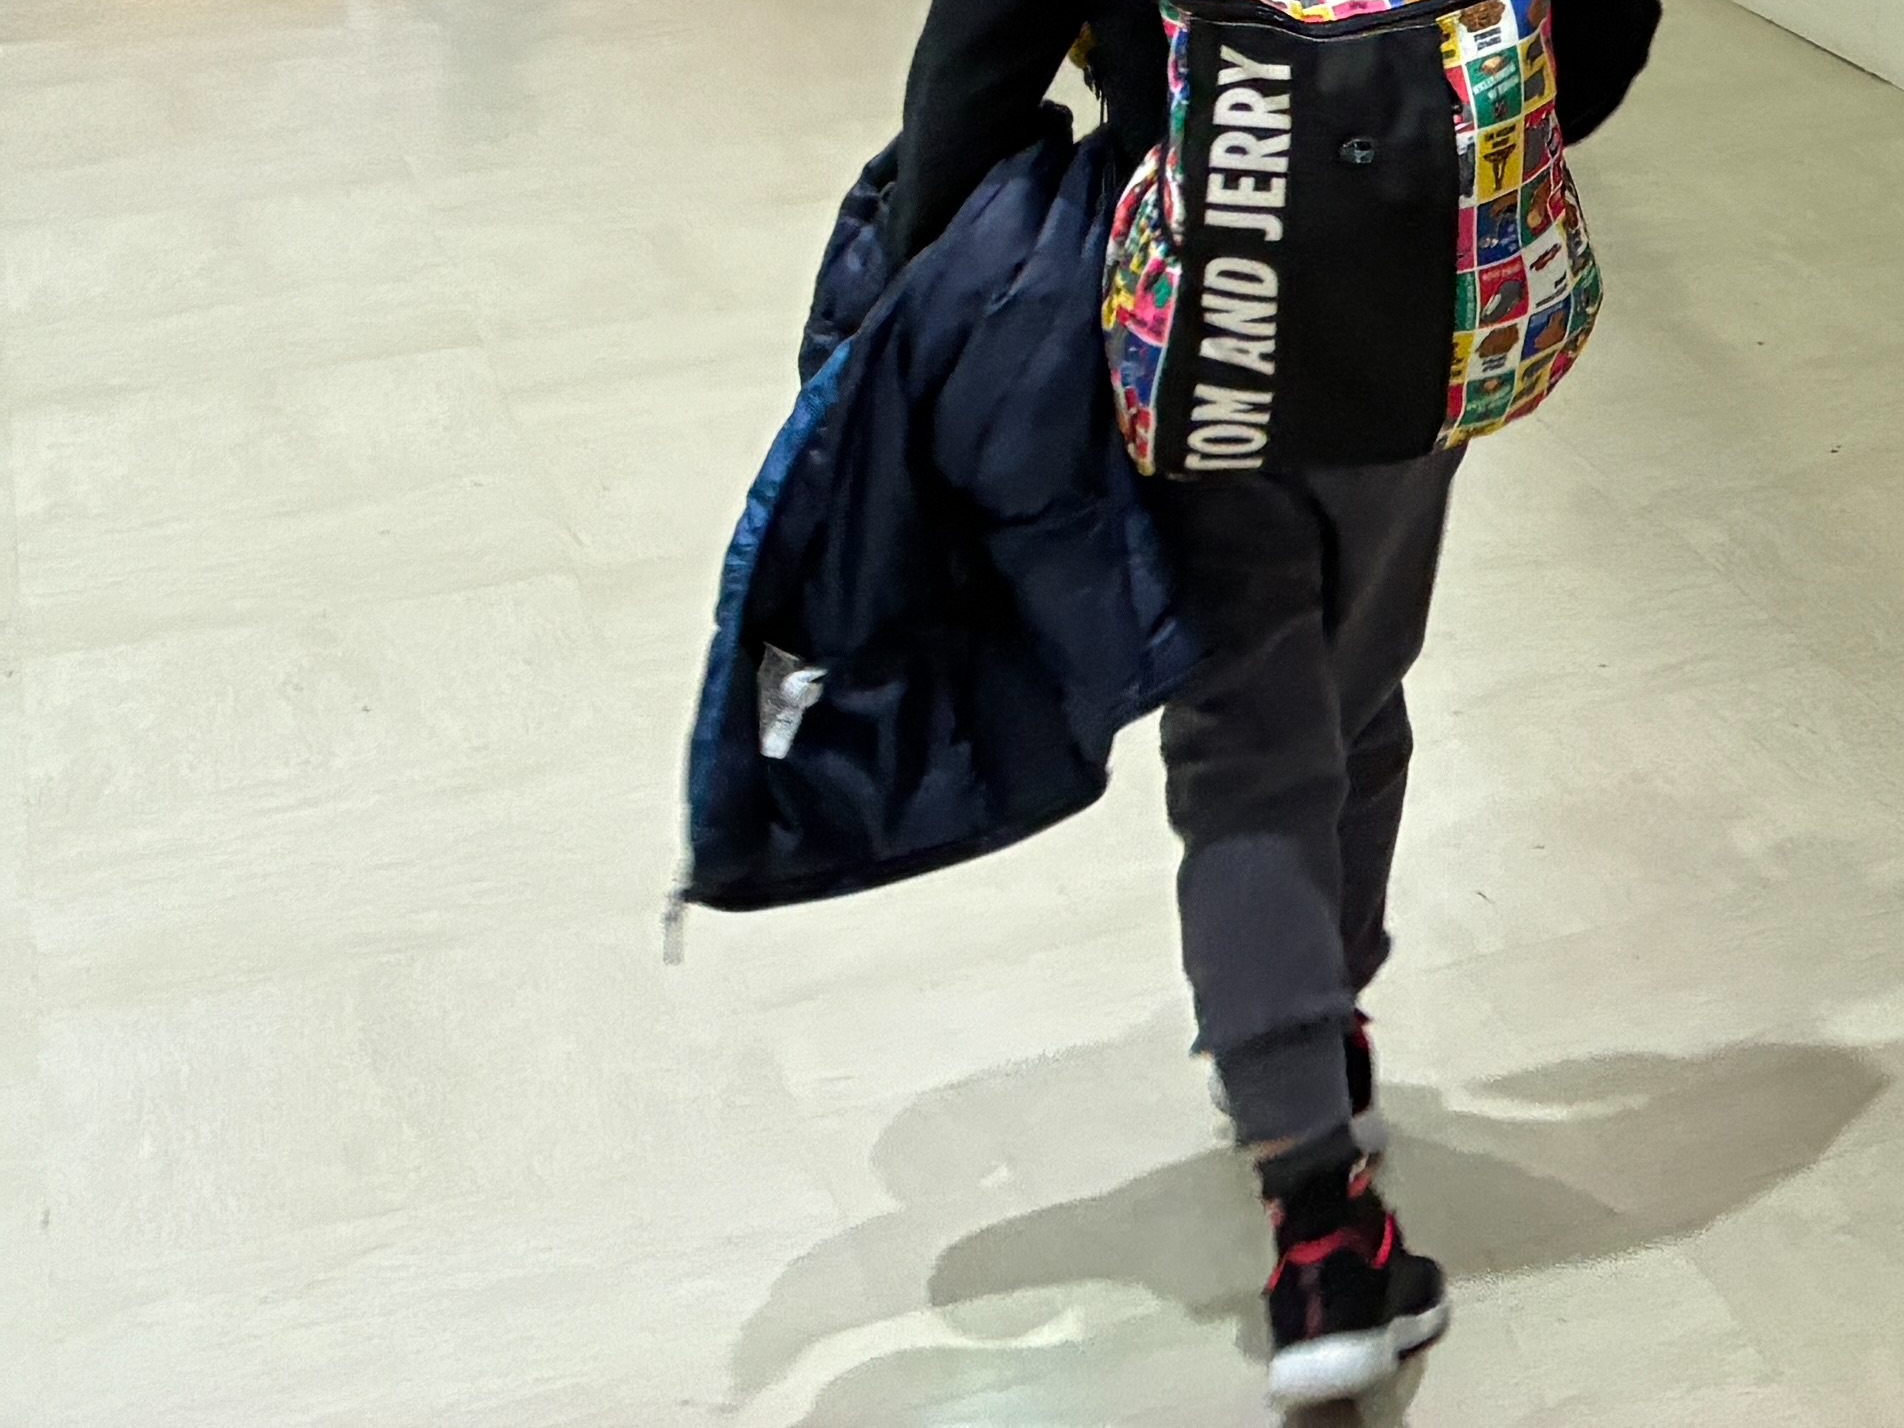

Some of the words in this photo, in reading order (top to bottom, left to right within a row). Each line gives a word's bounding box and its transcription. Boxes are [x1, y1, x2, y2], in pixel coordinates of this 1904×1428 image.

[1204, 44, 1293, 242] JERRY
[1199, 256, 1279, 376] AND
[1184, 383, 1275, 471] TOM
